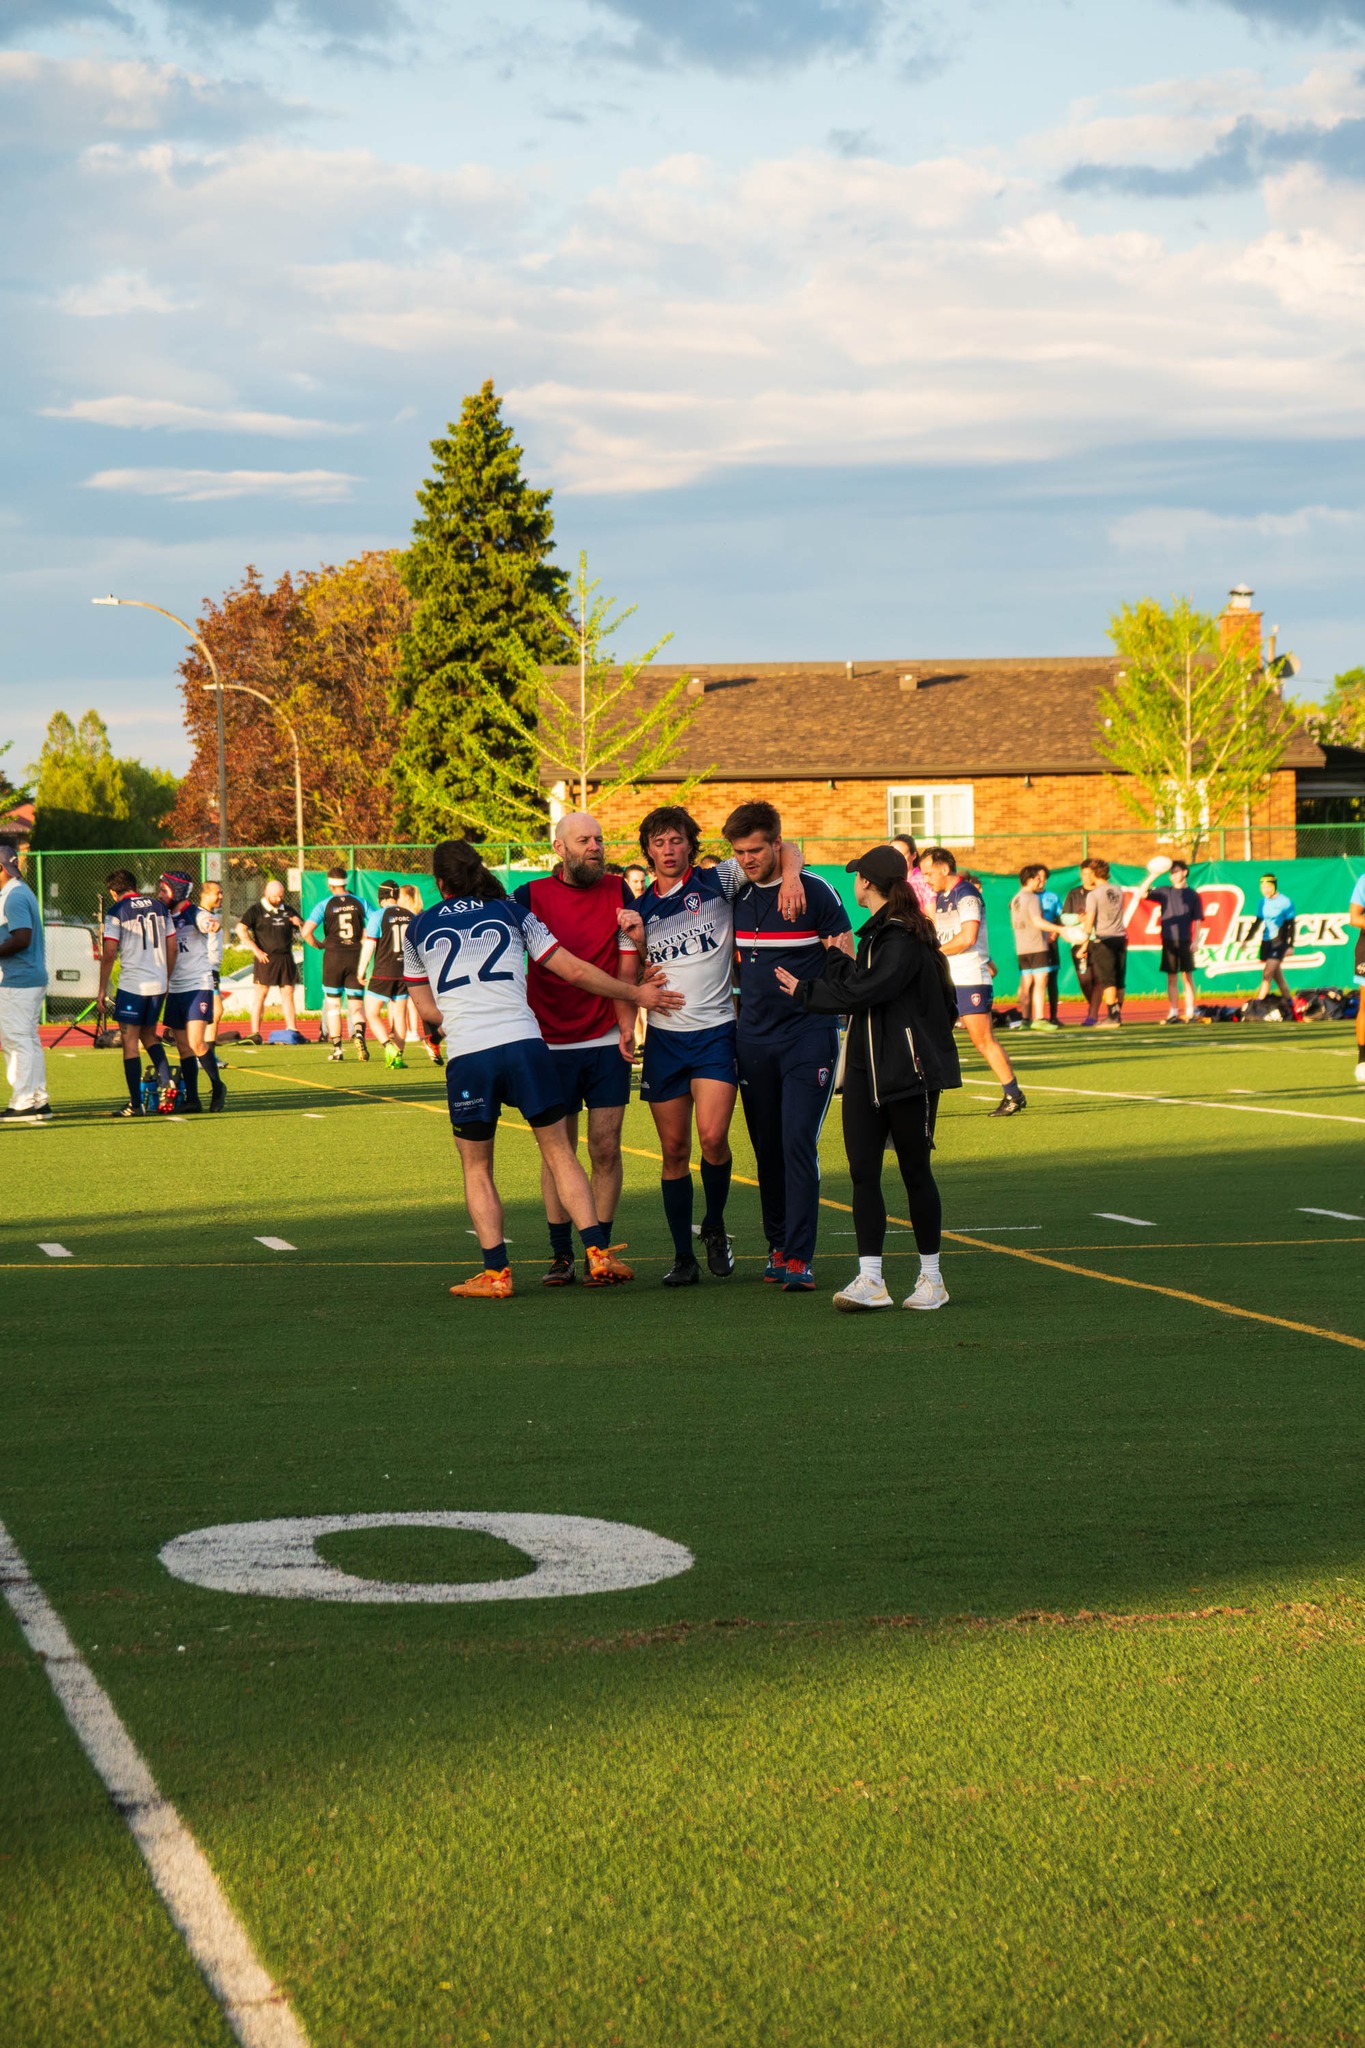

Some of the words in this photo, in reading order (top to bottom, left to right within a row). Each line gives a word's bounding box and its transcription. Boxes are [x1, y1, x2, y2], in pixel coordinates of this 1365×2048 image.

[438, 900, 484, 915] ASN
[137, 912, 159, 951] 11
[338, 913, 354, 939] 5
[656, 927, 701, 948] ENFANTS
[424, 919, 515, 994] 22
[649, 928, 719, 963] ROCK
[454, 1097, 484, 1107] conversion
